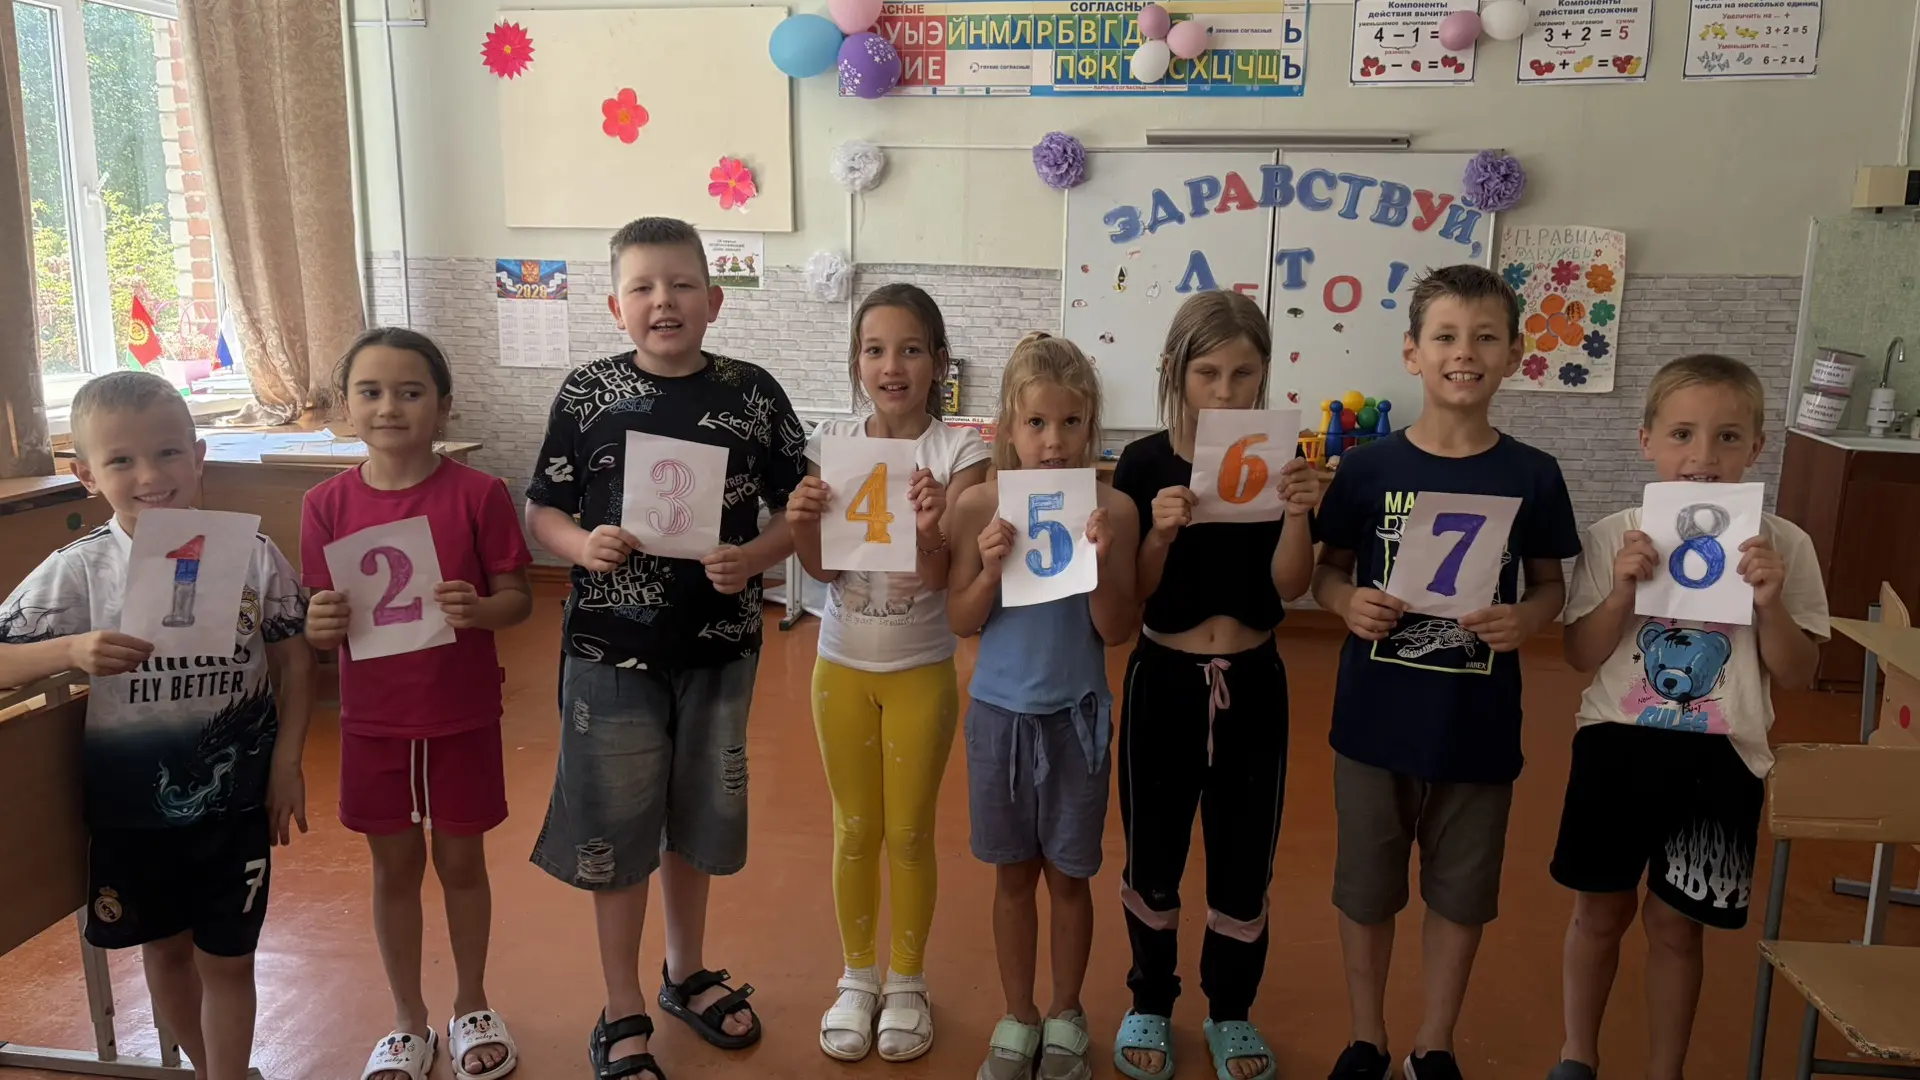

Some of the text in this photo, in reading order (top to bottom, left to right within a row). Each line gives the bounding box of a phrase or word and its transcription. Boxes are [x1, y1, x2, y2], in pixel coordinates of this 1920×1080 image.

[880, 5, 924, 14] АСНЫЕ
[1070, 2, 1154, 12] СОГЛАСНЫ
[1374, 27, 1384, 42] 4
[1412, 27, 1419, 42] 1
[1544, 28, 1554, 42] 3
[1581, 27, 1591, 41] 2
[1619, 26, 1629, 39] 5
[1515, 228, 1611, 247] ПРАВИЛА
[646, 459, 695, 537] 3
[725, 474, 751, 489] TREET
[1217, 433, 1269, 504] 6
[846, 463, 894, 543] 4
[1025, 491, 1073, 577] 5
[1426, 513, 1487, 597] 7
[1669, 503, 1730, 589] 8
[162, 535, 206, 628] 1
[360, 546, 423, 627] 2
[129, 671, 244, 704] FLY BETTER
[243, 858, 267, 914] 7
